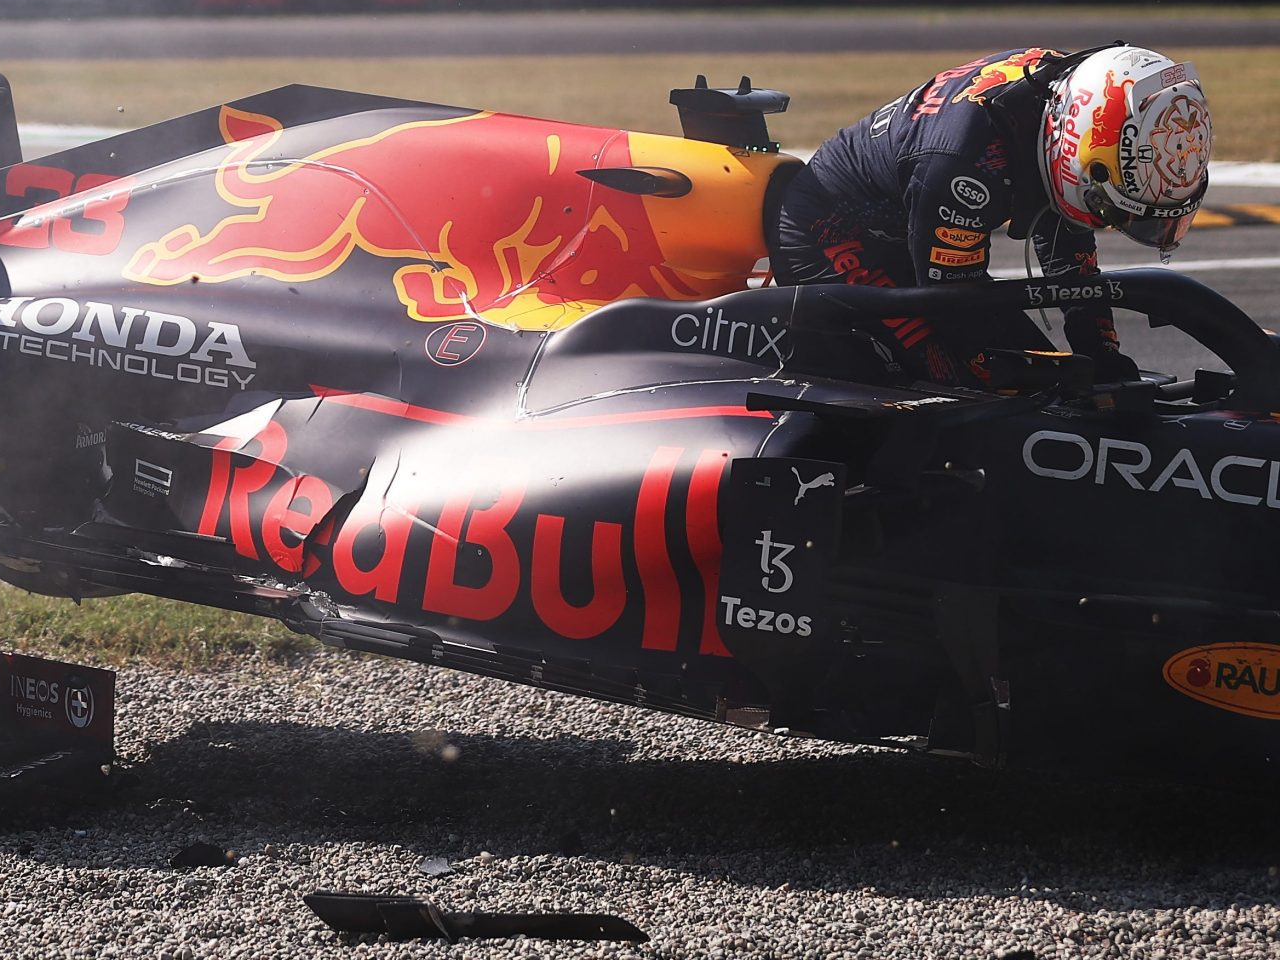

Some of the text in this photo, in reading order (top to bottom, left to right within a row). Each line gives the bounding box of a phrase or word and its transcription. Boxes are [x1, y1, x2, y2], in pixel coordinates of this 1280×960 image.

[935, 251, 980, 264] PIRELLI
[1046, 284, 1104, 304] Tezos
[670, 305, 789, 359] citrix
[721, 595, 812, 637] Tezos
[11, 674, 60, 704] INEOS
[16, 702, 53, 720] Hygienics
